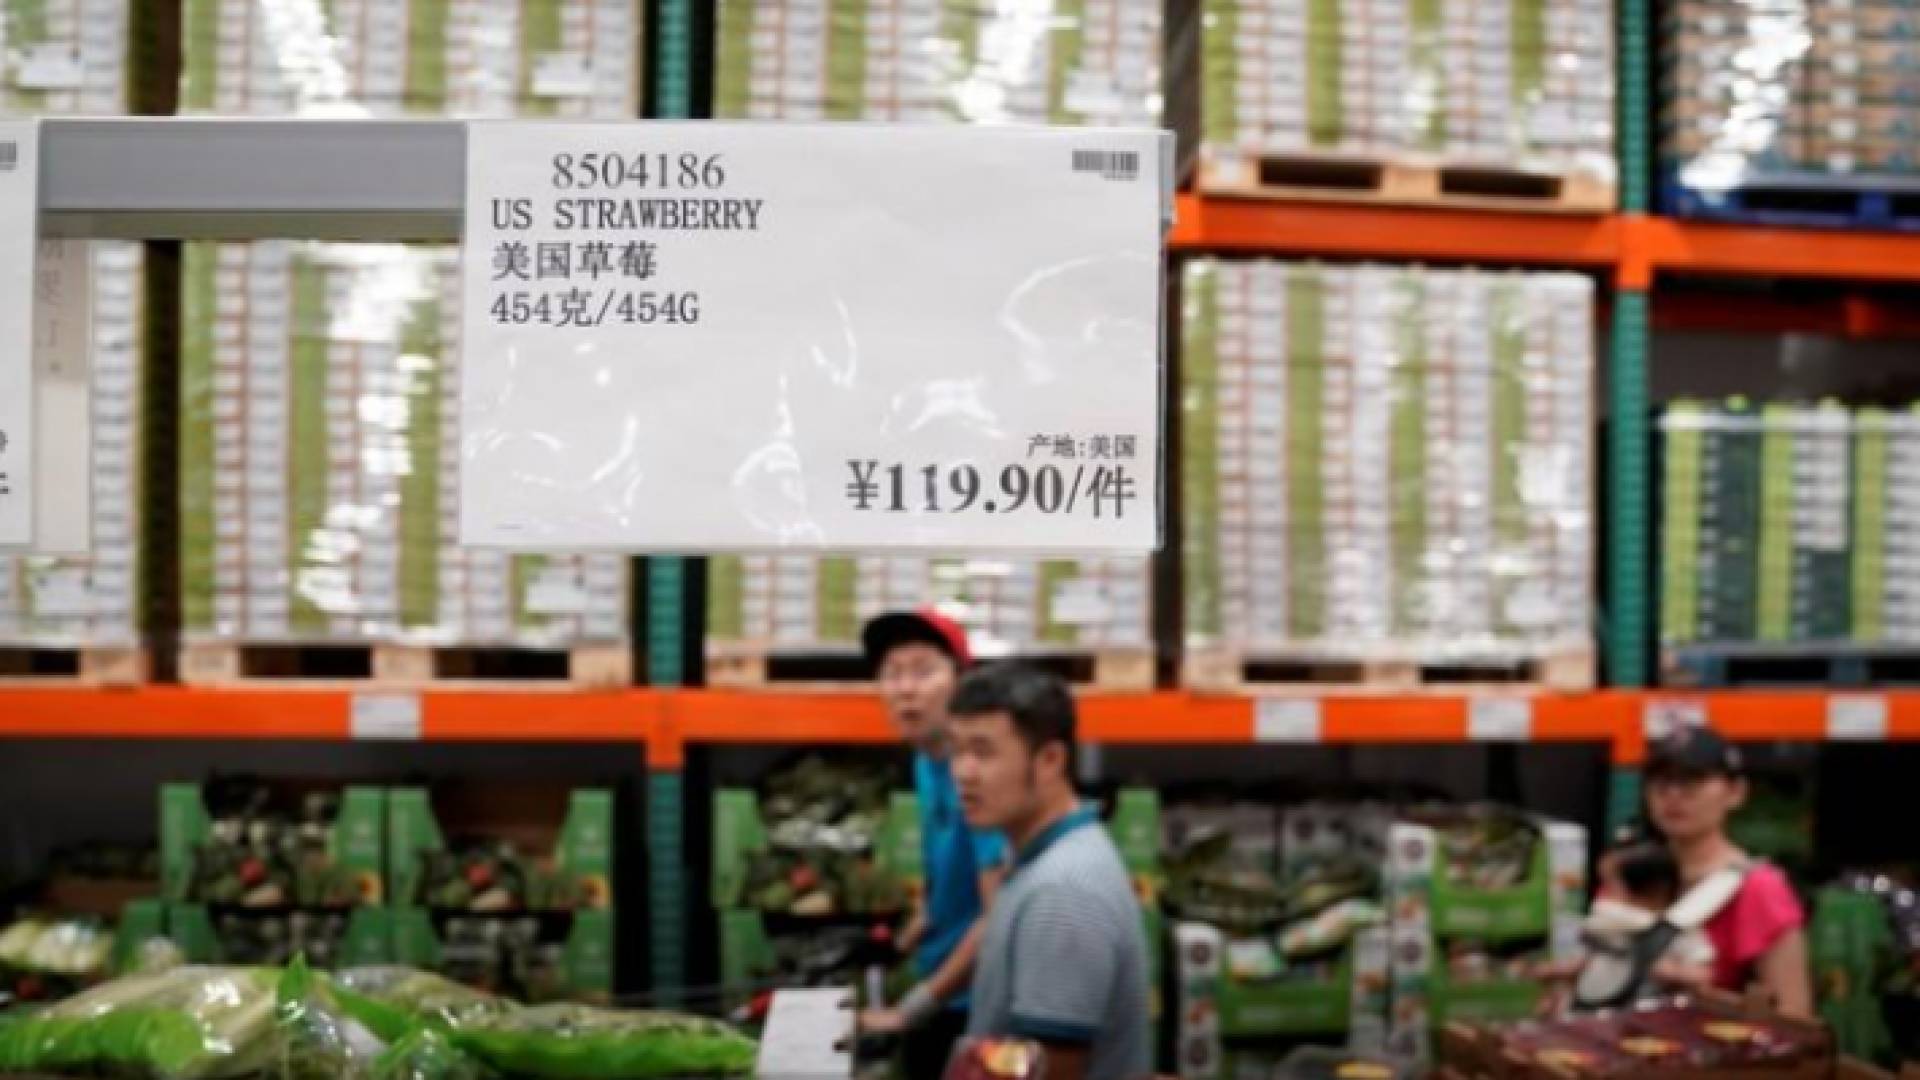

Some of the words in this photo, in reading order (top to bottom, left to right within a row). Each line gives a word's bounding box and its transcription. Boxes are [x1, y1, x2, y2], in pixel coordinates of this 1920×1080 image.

[552, 153, 725, 189] 8504186
[492, 198, 533, 230] US
[554, 198, 763, 230] STRAWBERRY
[492, 240, 657, 281] 美国草莓
[490, 286, 700, 327] 454克/454G
[846, 459, 1137, 518] ¥119.90/件
